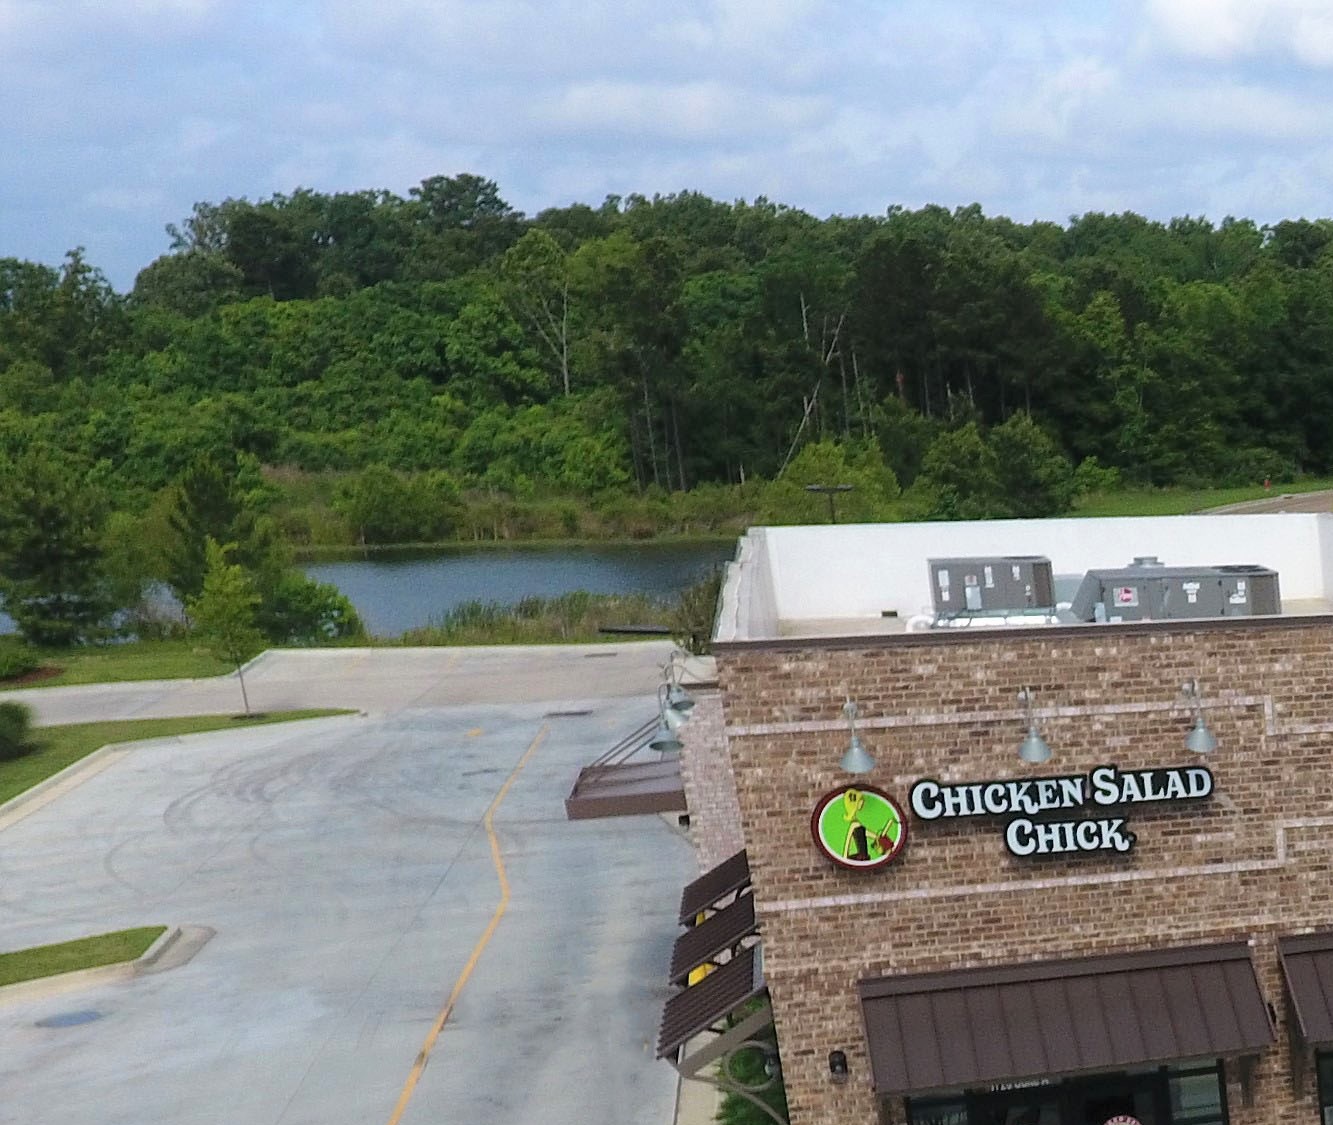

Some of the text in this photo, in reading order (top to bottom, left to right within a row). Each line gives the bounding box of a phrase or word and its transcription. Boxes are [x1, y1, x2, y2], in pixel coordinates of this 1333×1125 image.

[912, 768, 1212, 819] CHICKEN SALAD
[1006, 818, 1130, 855] CHICK
